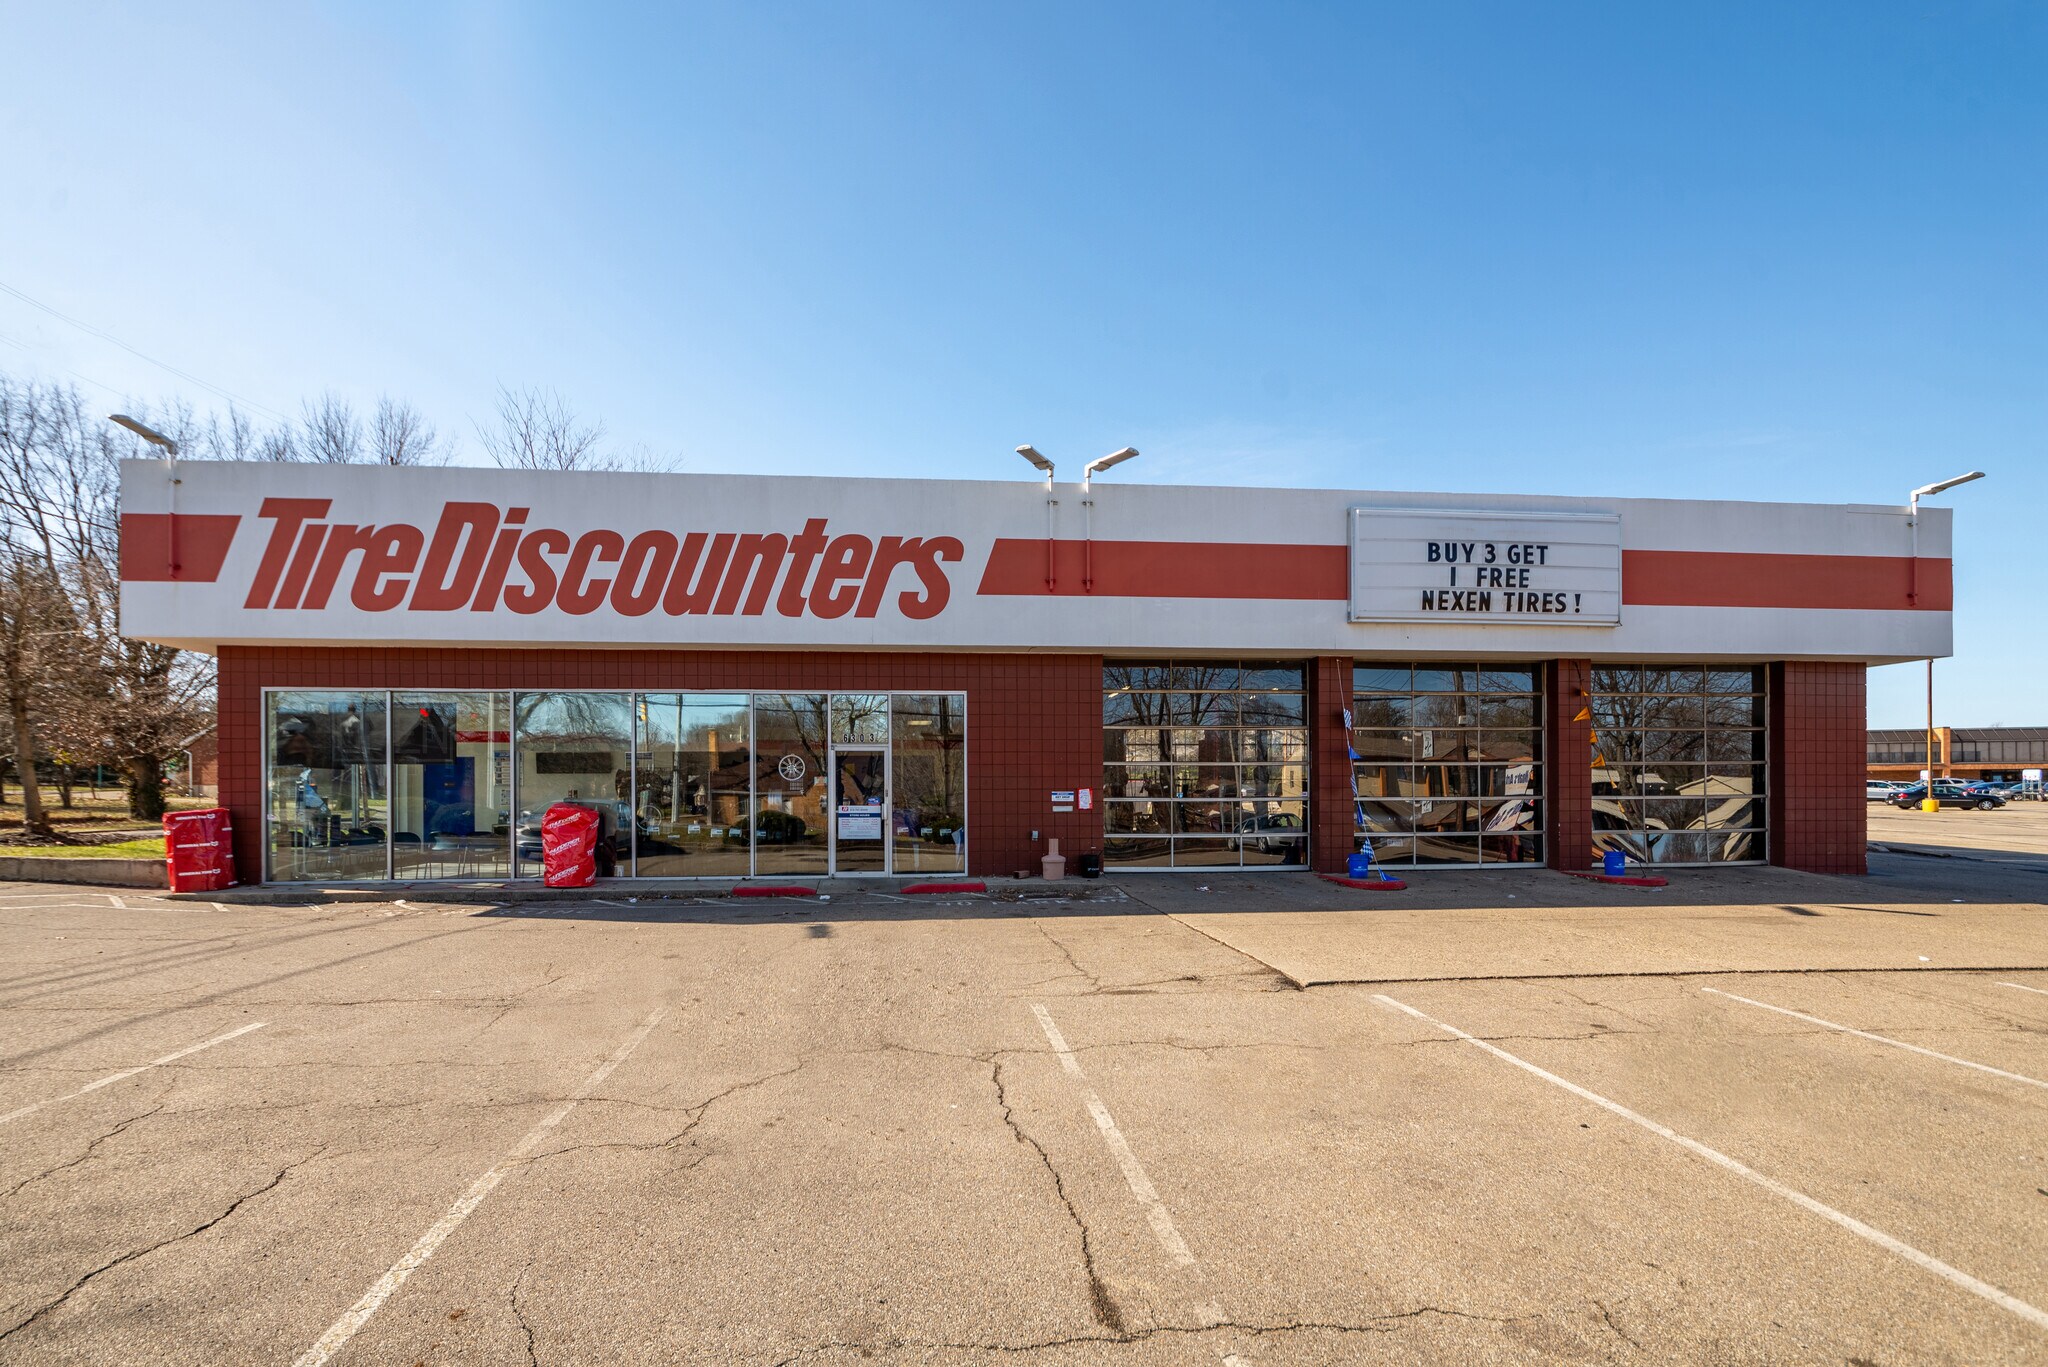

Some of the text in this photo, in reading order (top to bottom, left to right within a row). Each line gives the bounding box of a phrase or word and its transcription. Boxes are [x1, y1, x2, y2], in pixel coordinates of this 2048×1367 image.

[1427, 542, 1549, 565] BUY 3 GET
[1476, 567, 1530, 588] FREE
[1421, 590, 1491, 612] NEXEN
